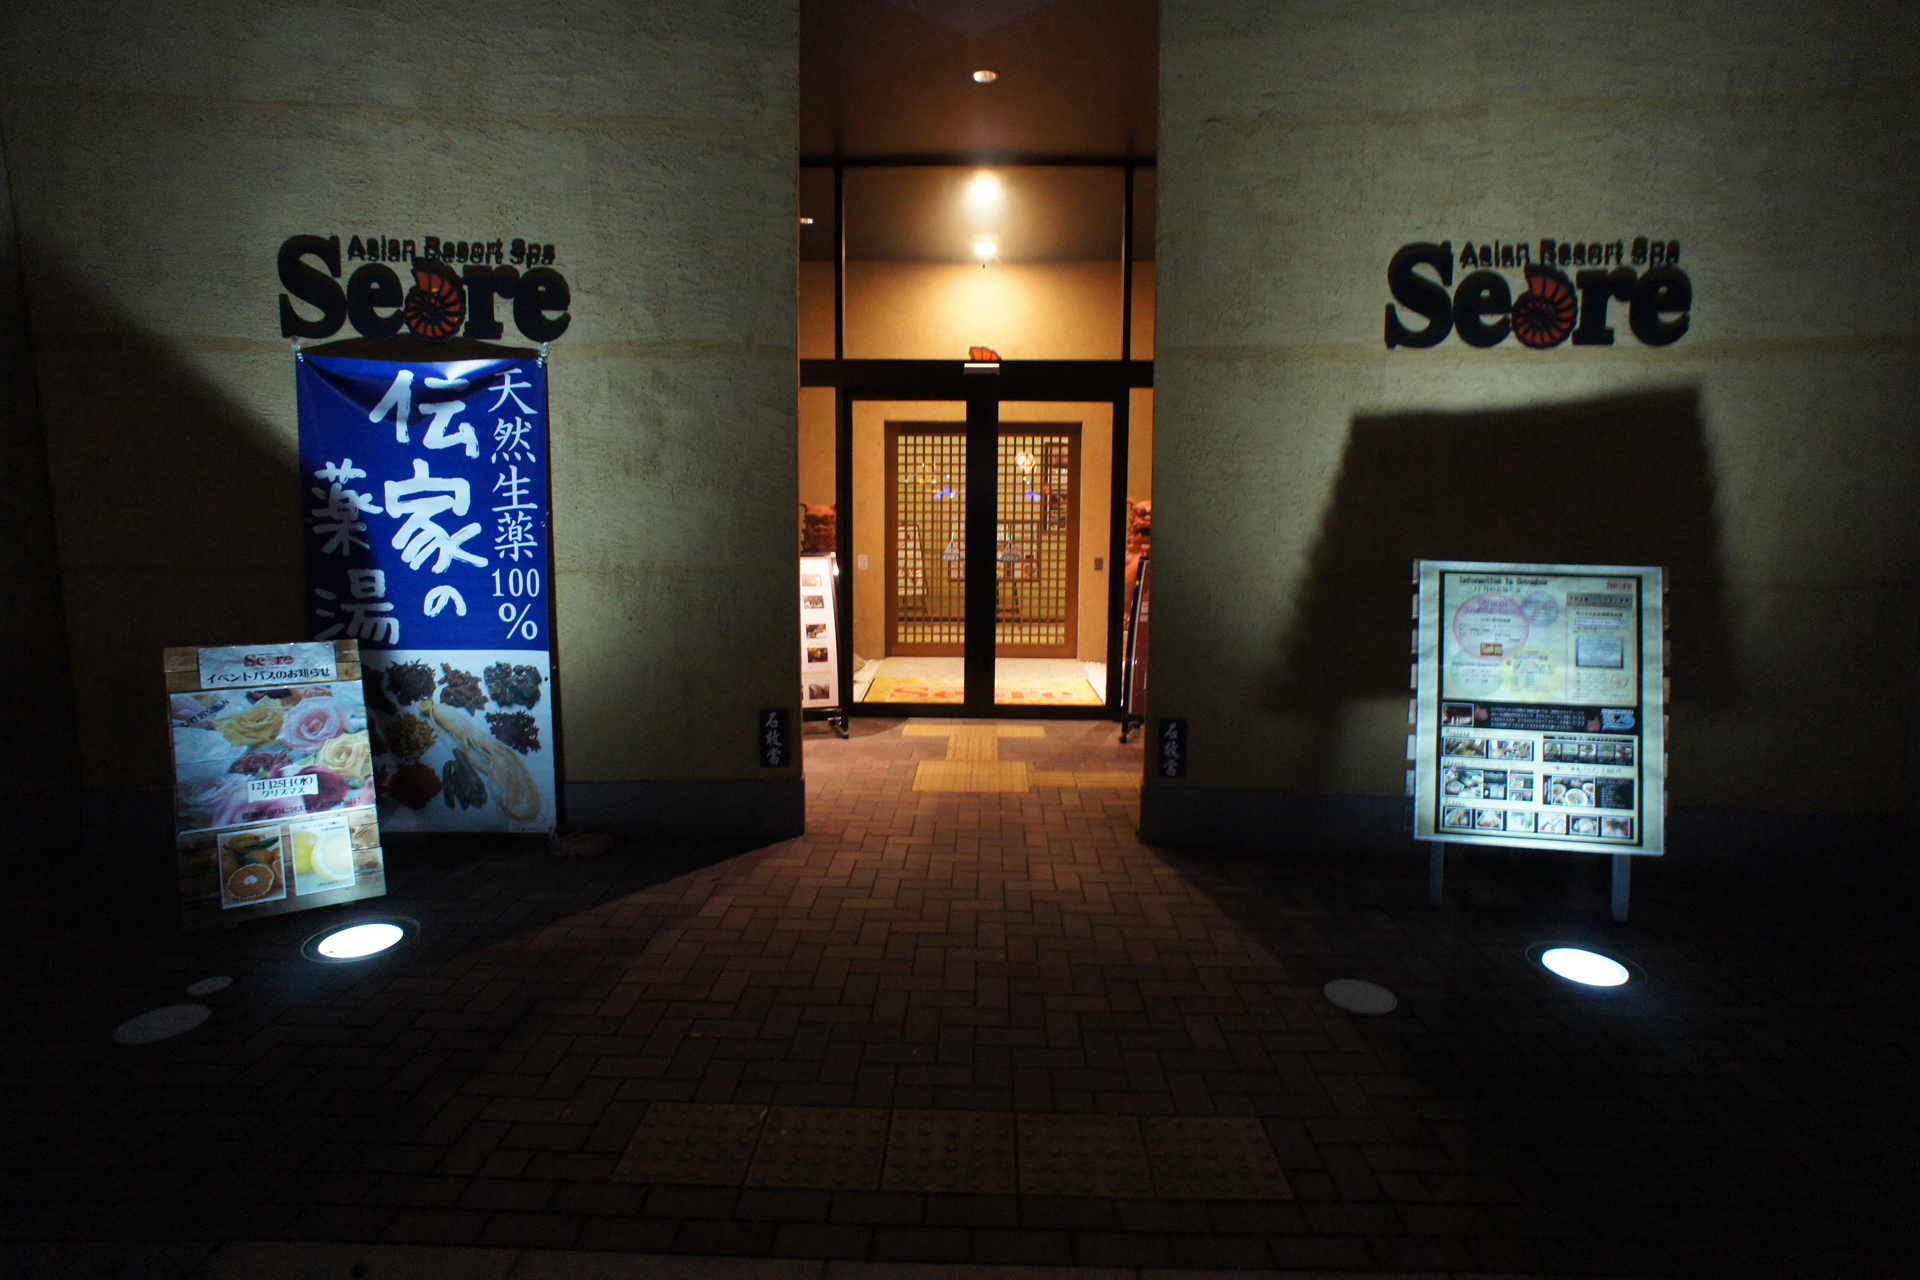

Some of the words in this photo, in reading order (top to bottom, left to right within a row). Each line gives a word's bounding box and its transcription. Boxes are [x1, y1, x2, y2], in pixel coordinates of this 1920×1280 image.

[348, 235, 415, 262] Asian
[425, 236, 503, 265] Resort
[510, 238, 555, 269] Spa
[1459, 240, 1529, 269] Asian
[1540, 238, 1624, 267] Resort
[1631, 236, 1681, 270] Spa
[261, 786, 306, 798] クリスマス
